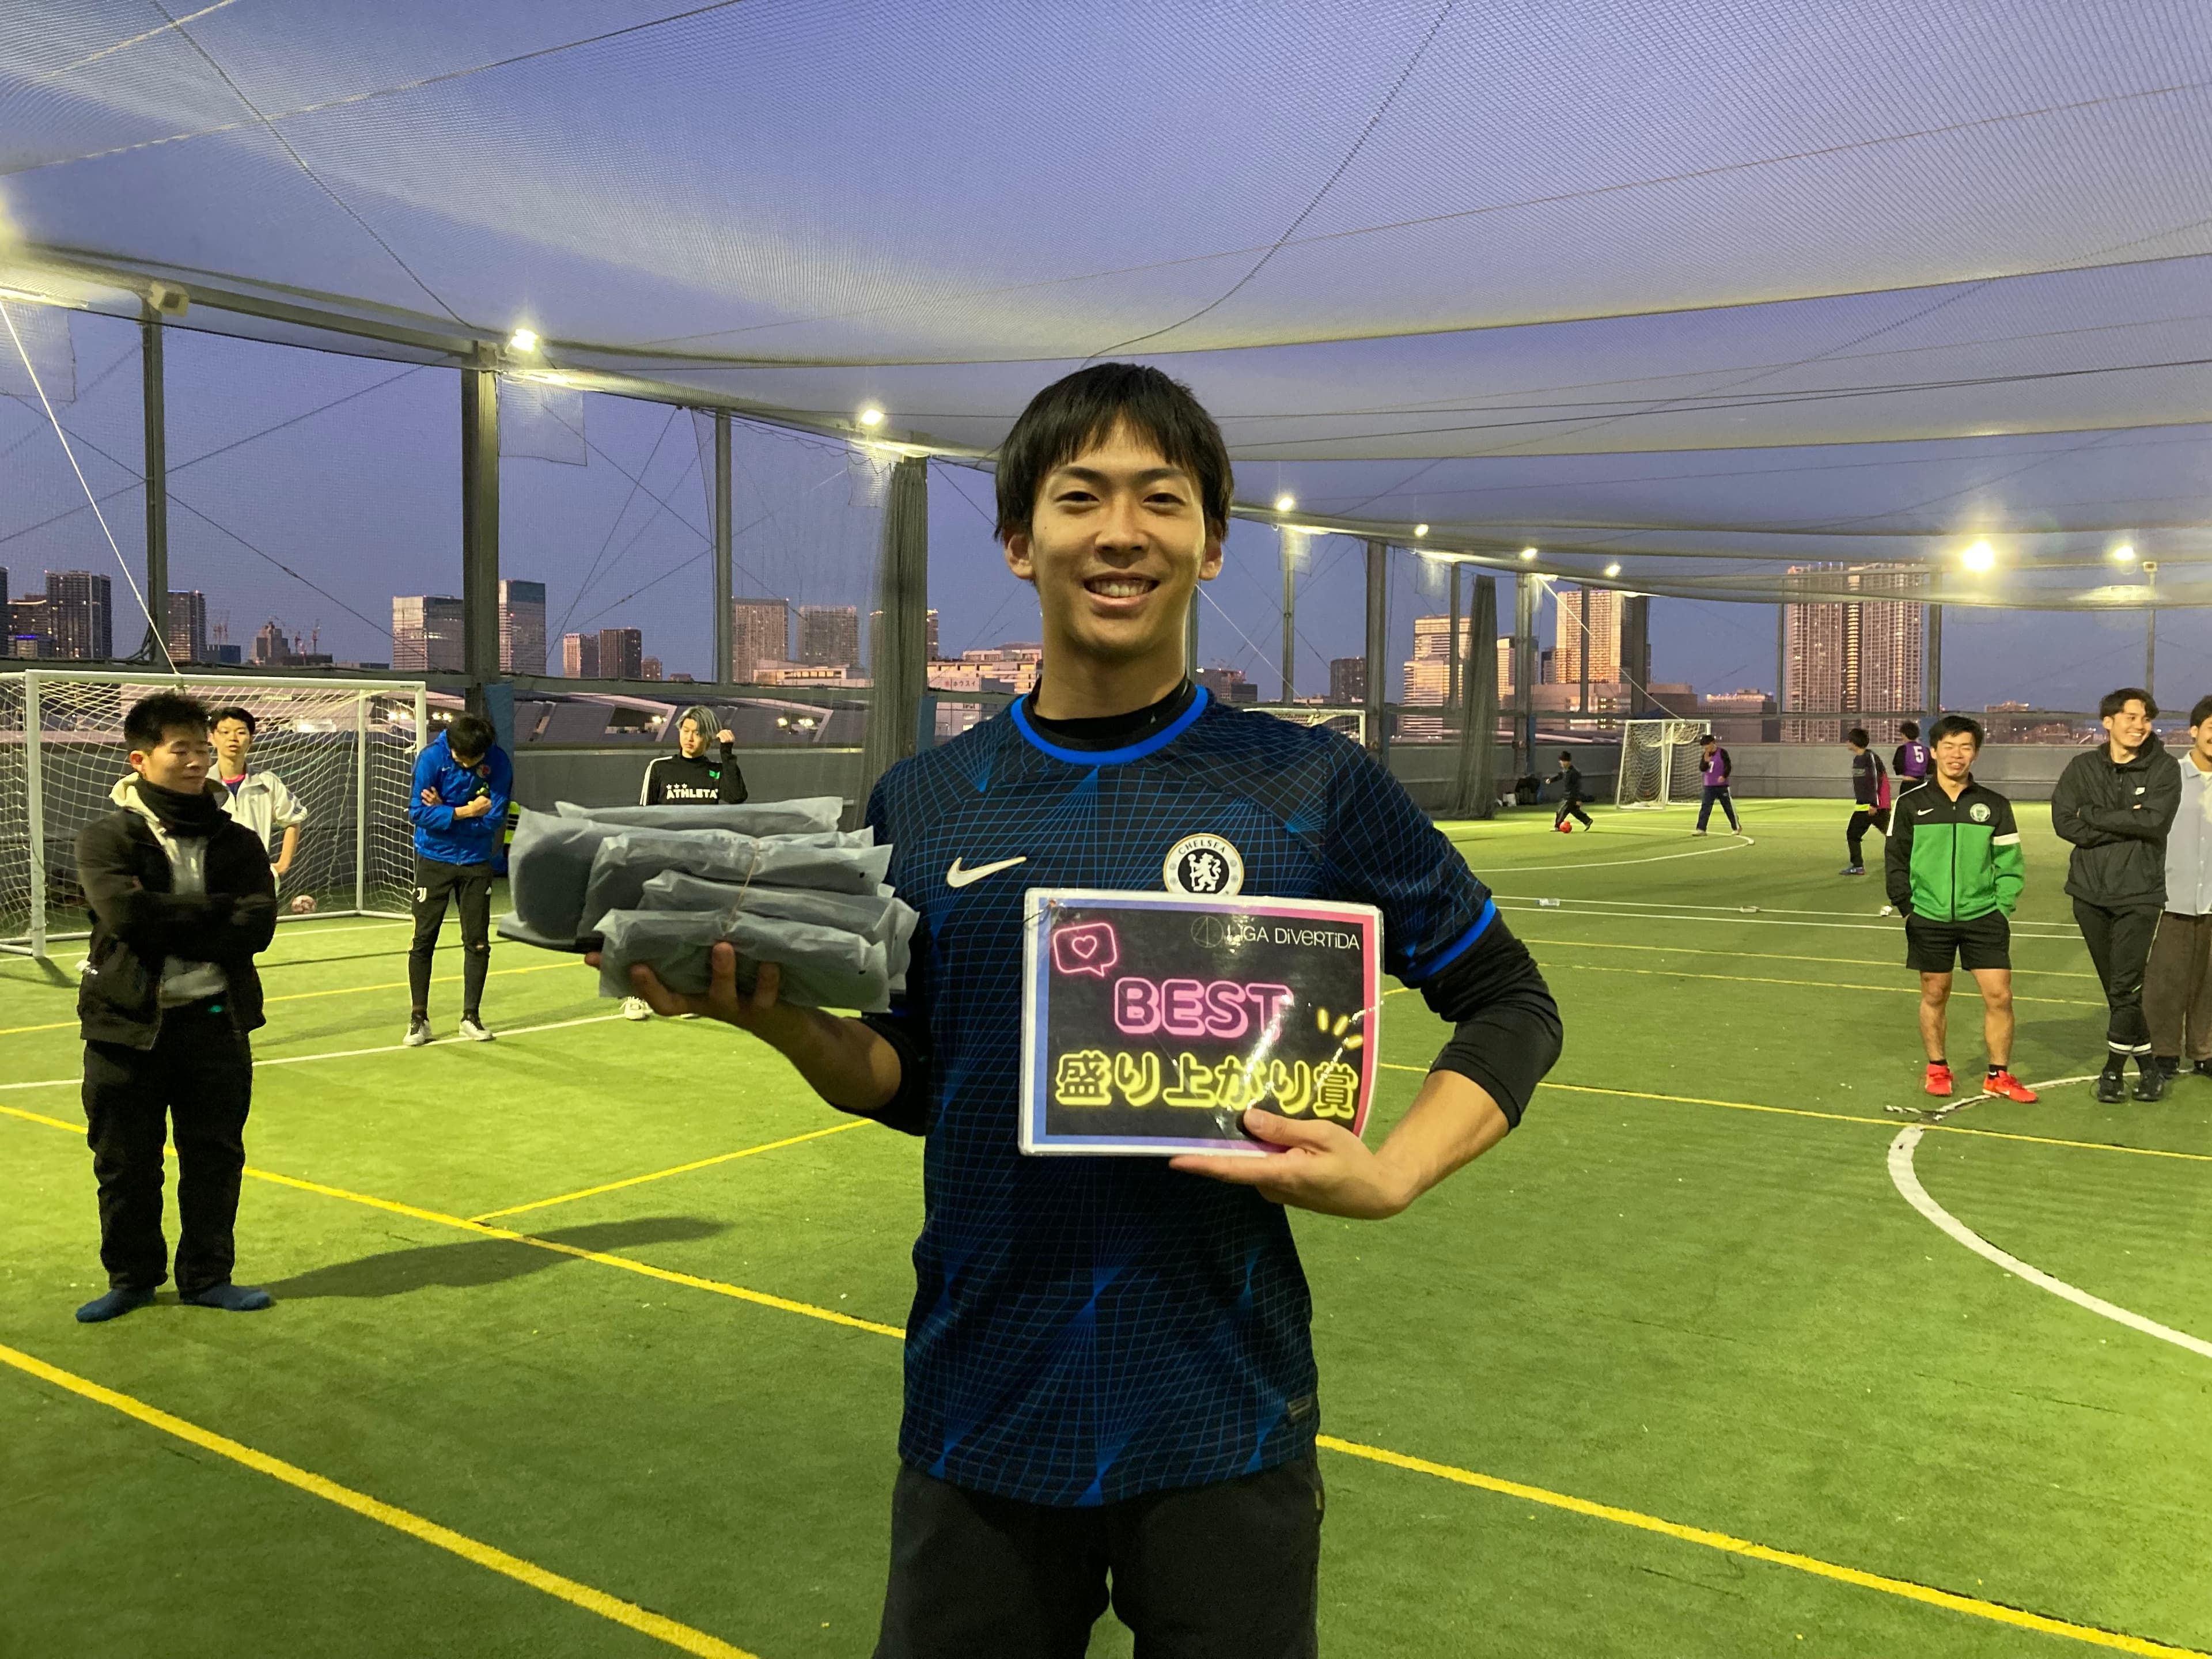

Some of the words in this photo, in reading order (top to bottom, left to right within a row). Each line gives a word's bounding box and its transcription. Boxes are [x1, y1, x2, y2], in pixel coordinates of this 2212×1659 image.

[1913, 745, 1924, 763] 5
[666, 788, 718, 800] ATHLETA
[1178, 839, 1226, 854] CHELSEA
[1114, 977, 1294, 1041] BEST
[1055, 1050, 1358, 1120] 盛り上がり賞
